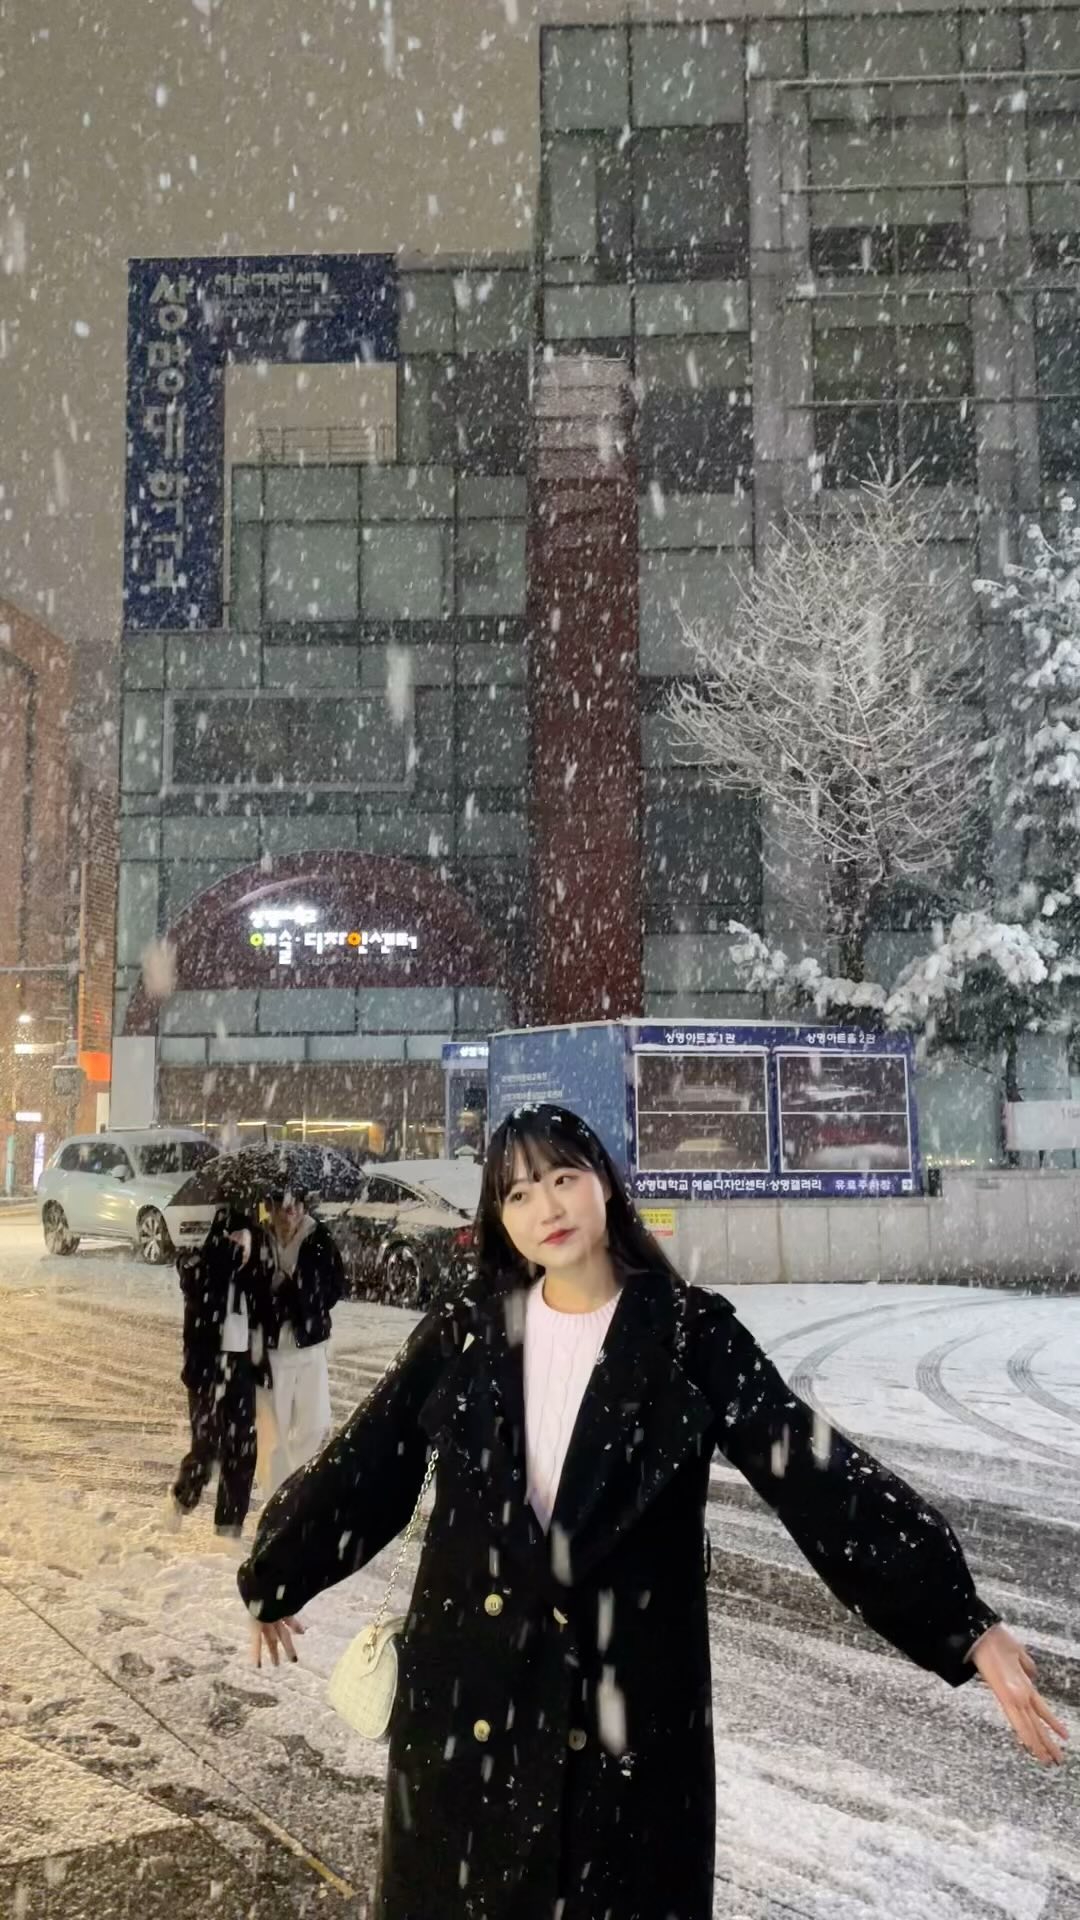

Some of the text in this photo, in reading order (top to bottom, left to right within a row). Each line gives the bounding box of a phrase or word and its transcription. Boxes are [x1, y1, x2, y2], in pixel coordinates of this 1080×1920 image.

[143, 273, 195, 588] 상명대학교
[665, 1032, 717, 1044] 상명아트홀
[807, 1032, 857, 1044] 상명아트홀
[635, 1179, 689, 1192] 상명대학교
[835, 1179, 892, 1192] 유료주차장
